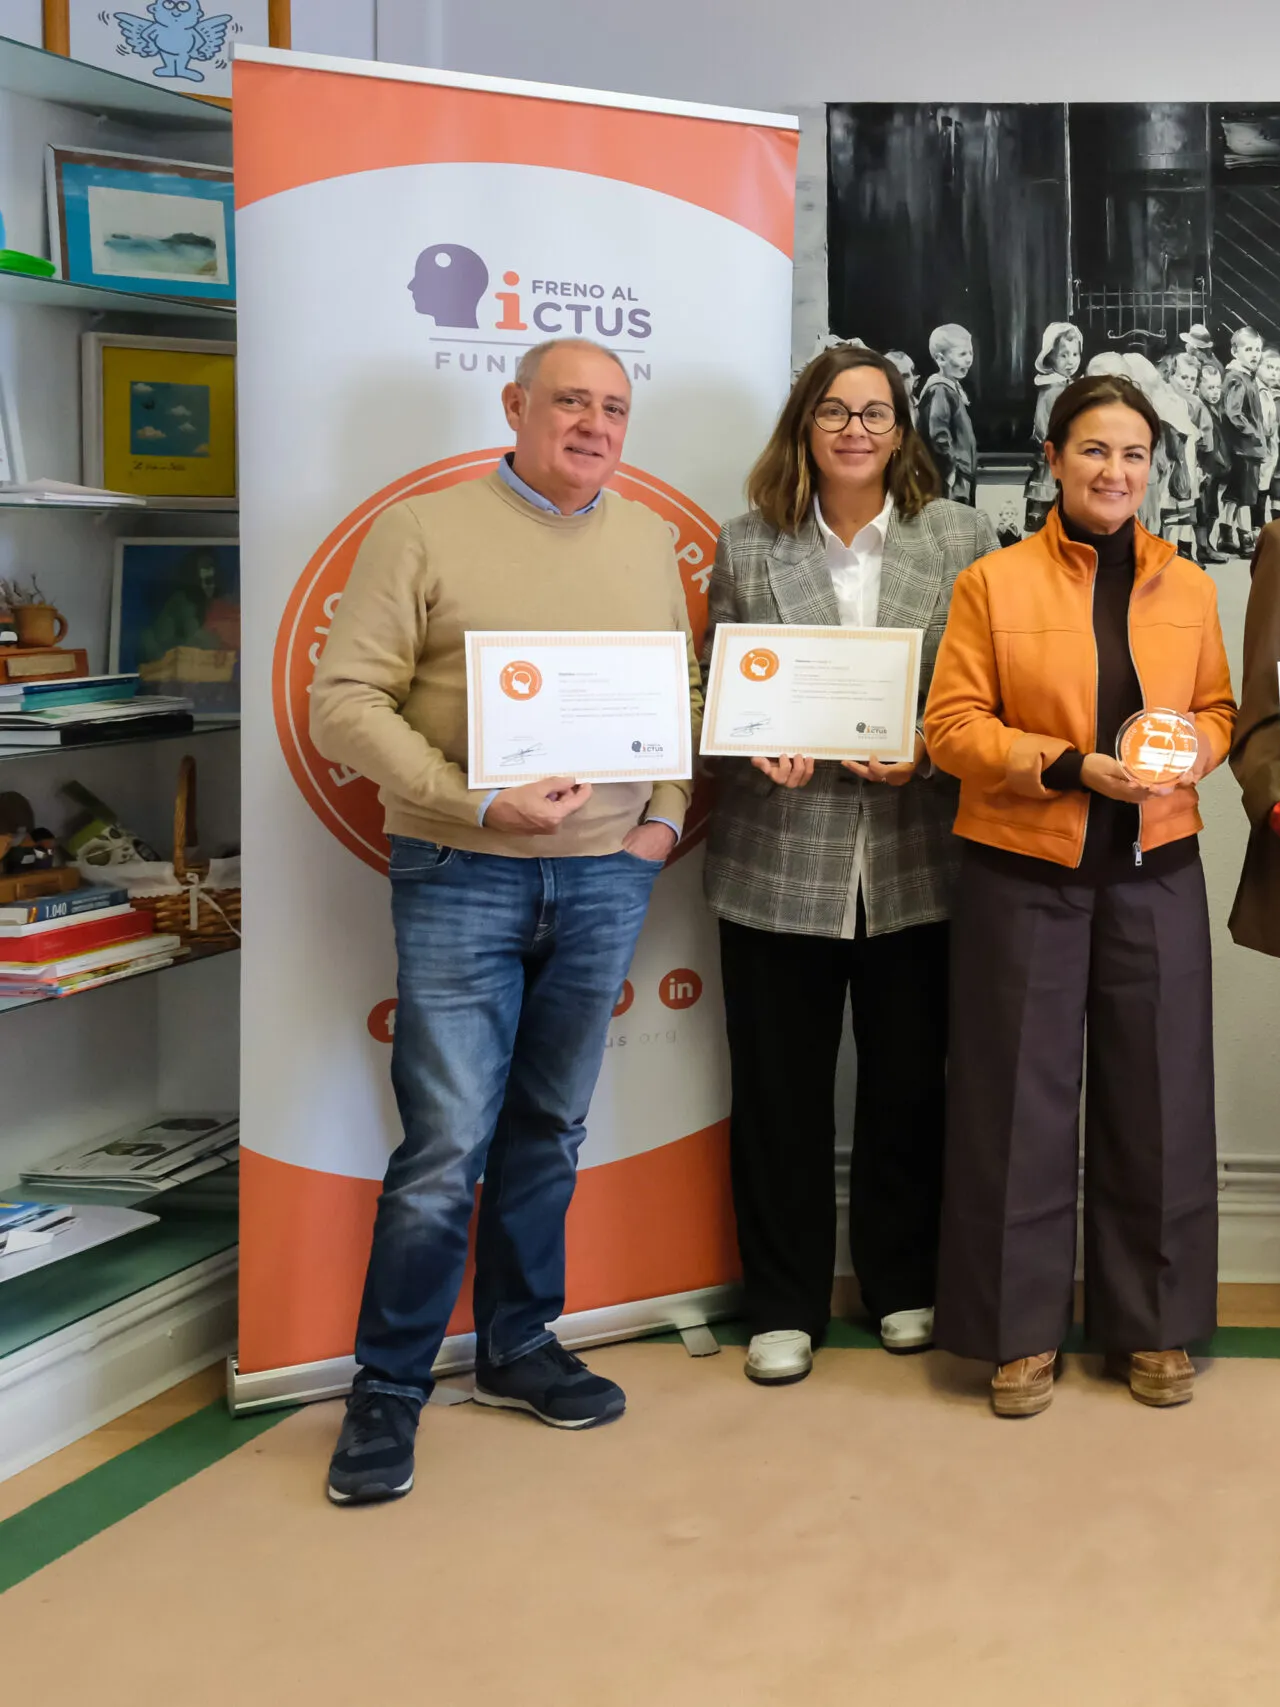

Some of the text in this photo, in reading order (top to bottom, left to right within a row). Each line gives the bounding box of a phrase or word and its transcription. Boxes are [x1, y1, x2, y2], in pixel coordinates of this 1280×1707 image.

[531, 279, 639, 302] FRENO AL
[494, 270, 652, 339] iCTUS
[45, 902, 67, 918] 1.040
[669, 977, 693, 1000] in
